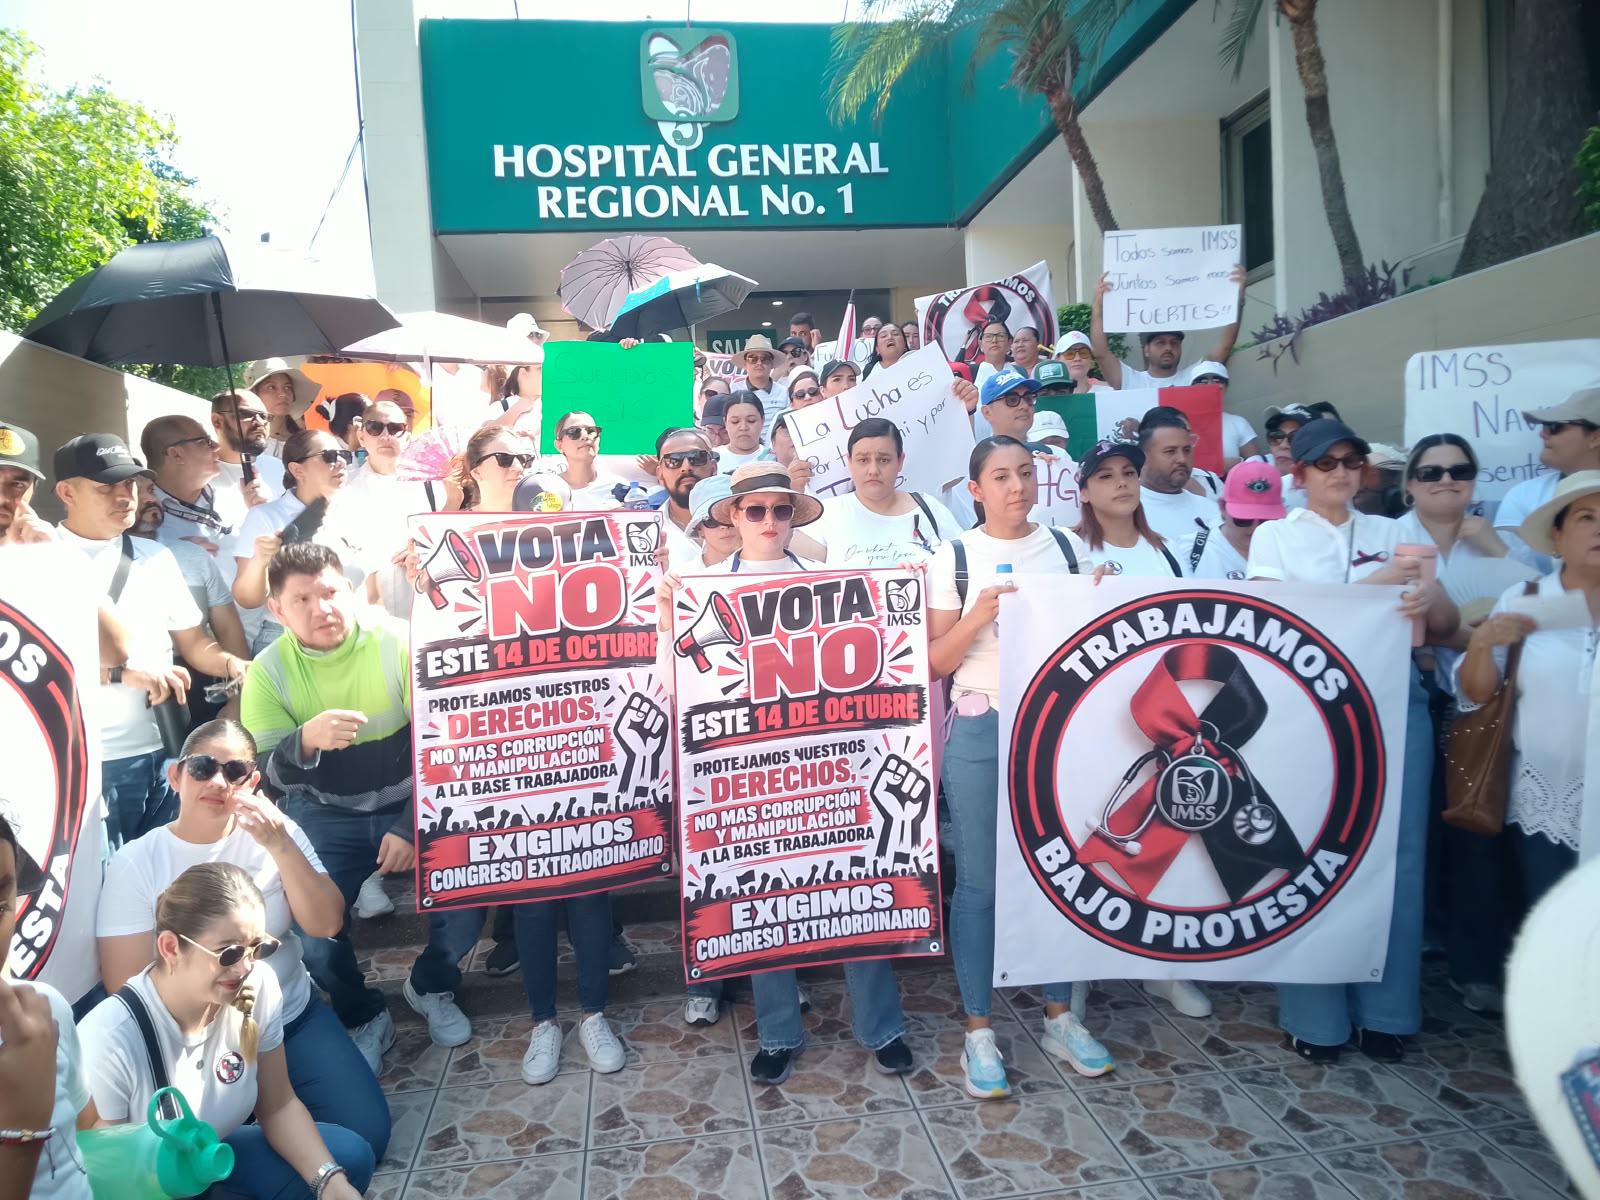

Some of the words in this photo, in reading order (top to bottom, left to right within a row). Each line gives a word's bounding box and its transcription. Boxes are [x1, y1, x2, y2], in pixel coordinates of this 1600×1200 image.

[494, 144, 696, 178] HOSPITAL
[708, 142, 889, 177] GENERAL
[537, 184, 749, 219] REGIONAL
[762, 183, 825, 216] No.
[837, 183, 854, 214] 1
[1106, 234, 1156, 262] Todos
[1202, 230, 1238, 251] IMSS
[1419, 352, 1512, 390] IMSS
[789, 414, 831, 446] La
[835, 387, 902, 430] Lucha
[907, 371, 933, 391] es
[477, 519, 617, 575] VOTA
[489, 563, 625, 639] NO
[741, 577, 876, 638] VOTA
[887, 612, 921, 626] IMSS
[426, 643, 490, 678] ESTE
[493, 643, 523, 668] 14
[529, 638, 561, 666] DE
[752, 625, 880, 702] NO
[1059, 602, 1350, 701] TRABAJAMOS
[429, 687, 532, 713] PROTEJAMOS
[535, 677, 610, 698] NUESTROS
[691, 707, 750, 742] ESTE
[754, 706, 783, 731] 14
[788, 701, 819, 728] DE
[824, 692, 919, 722] OCTUBRE
[448, 696, 601, 740] DERECHOS,
[430, 747, 455, 766] NO
[459, 743, 497, 762] MAS
[501, 726, 605, 757] CORRUPCIÓN
[452, 765, 465, 780] Y
[469, 746, 600, 778] MANIPULACIÓN
[693, 750, 790, 778] PROTEJAMOS
[794, 739, 866, 761] NUESTROS
[435, 785, 447, 799] A
[450, 783, 468, 798] LA
[472, 778, 511, 796] BASE
[515, 763, 618, 791] TRABAJADORA
[710, 757, 857, 805] DERECHOS,
[694, 814, 718, 832] NO
[721, 808, 757, 828] MAS
[761, 788, 861, 819] CORRUPCIÓN
[715, 829, 727, 844] Y
[732, 808, 856, 841] MANIPULACIÓN
[1171, 804, 1216, 821] IMSS
[468, 817, 633, 863] EXIGIMOS
[700, 852, 712, 866] A
[713, 848, 730, 864] LA
[734, 842, 770, 860] BASE
[774, 826, 875, 853] TRABAJADORA
[430, 860, 523, 892] CONGRESO
[527, 836, 664, 880] EXTRAORDINARIO
[731, 883, 894, 931] EXIGIMOS
[1034, 836, 1131, 932] BAJO
[1140, 847, 1349, 948] PROTESTA
[696, 926, 784, 962] CONGRESO
[788, 907, 930, 946] EXTRAORDINARIO
